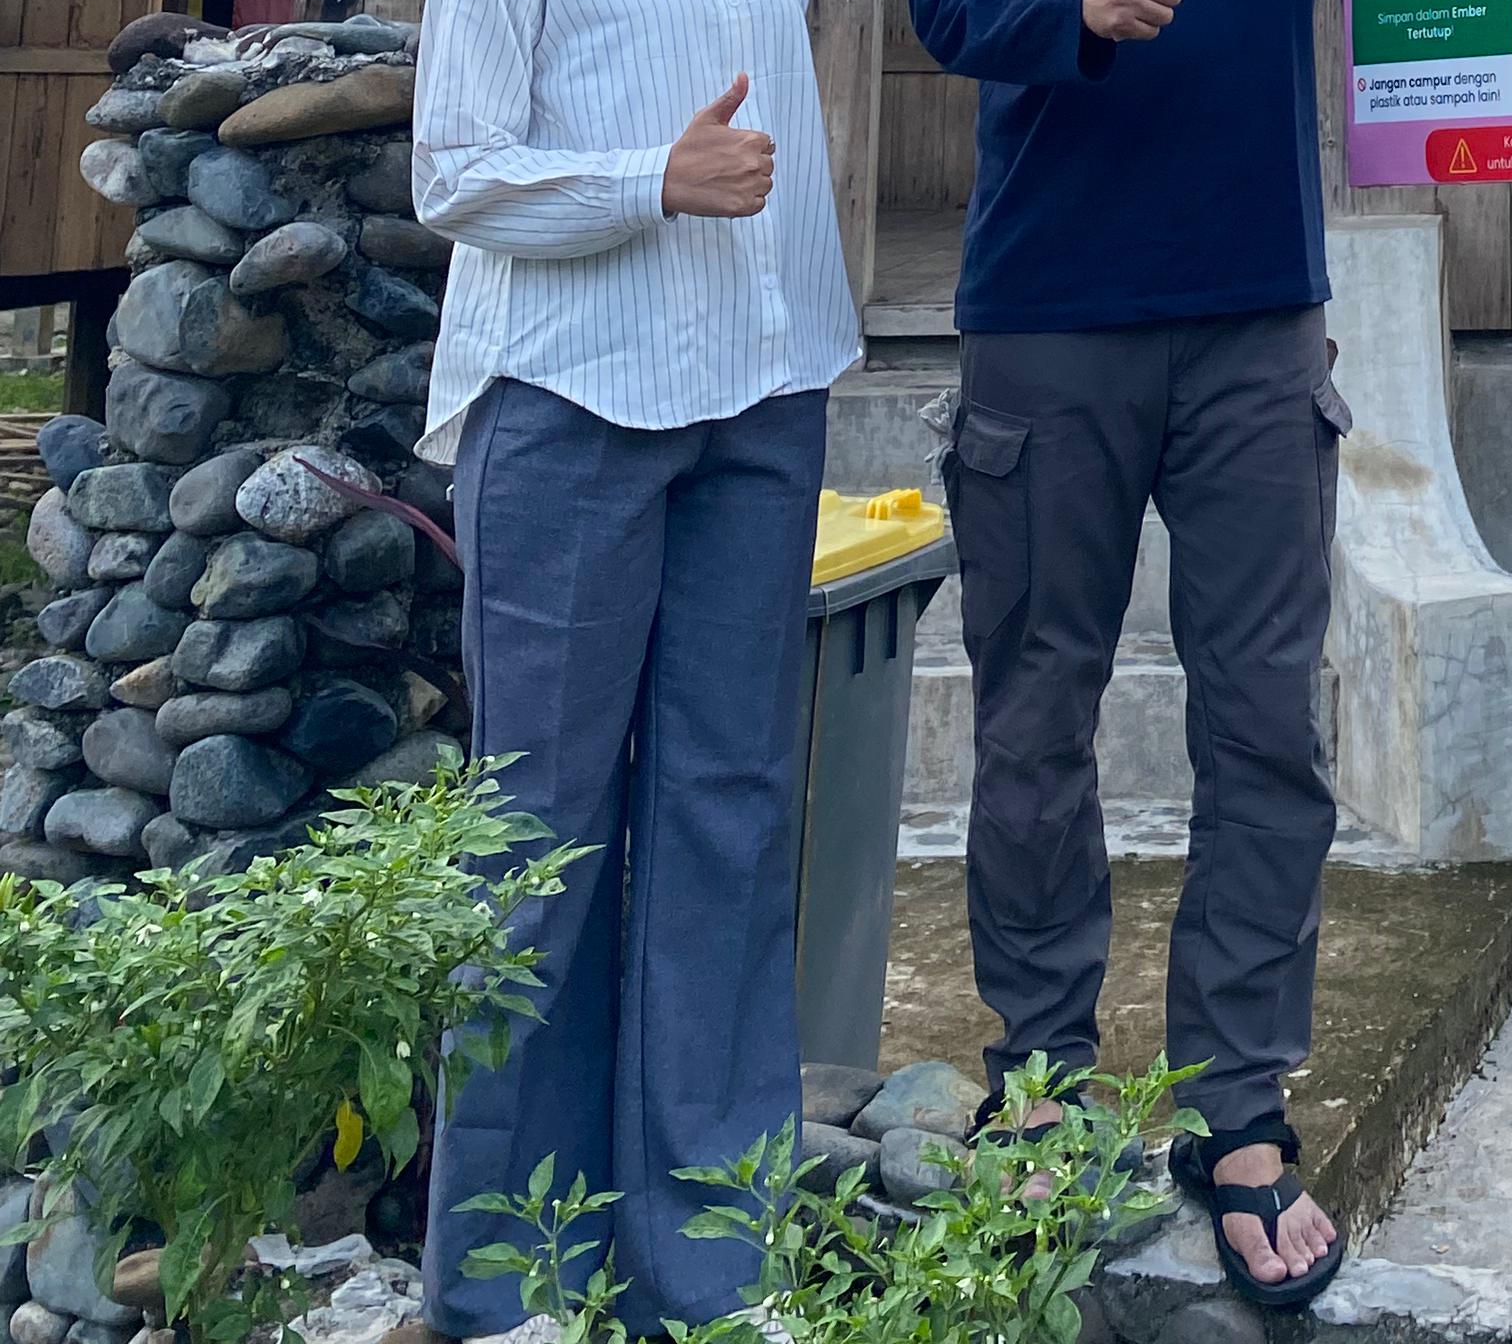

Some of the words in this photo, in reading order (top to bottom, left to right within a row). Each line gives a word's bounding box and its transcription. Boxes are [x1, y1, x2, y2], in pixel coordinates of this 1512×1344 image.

[1378, 12, 1413, 27] Simpan
[1416, 9, 1449, 20] dalam
[1452, 5, 1487, 18] Ember
[1407, 25, 1453, 40] Tertutup!
[1370, 76, 1406, 93] Jangan
[1409, 75, 1451, 90] campur
[1454, 72, 1496, 86] dengan
[1370, 95, 1400, 112] plastik
[1403, 94, 1427, 107] atau
[1431, 90, 1475, 107] sampah
[1478, 89, 1500, 102] lain!
